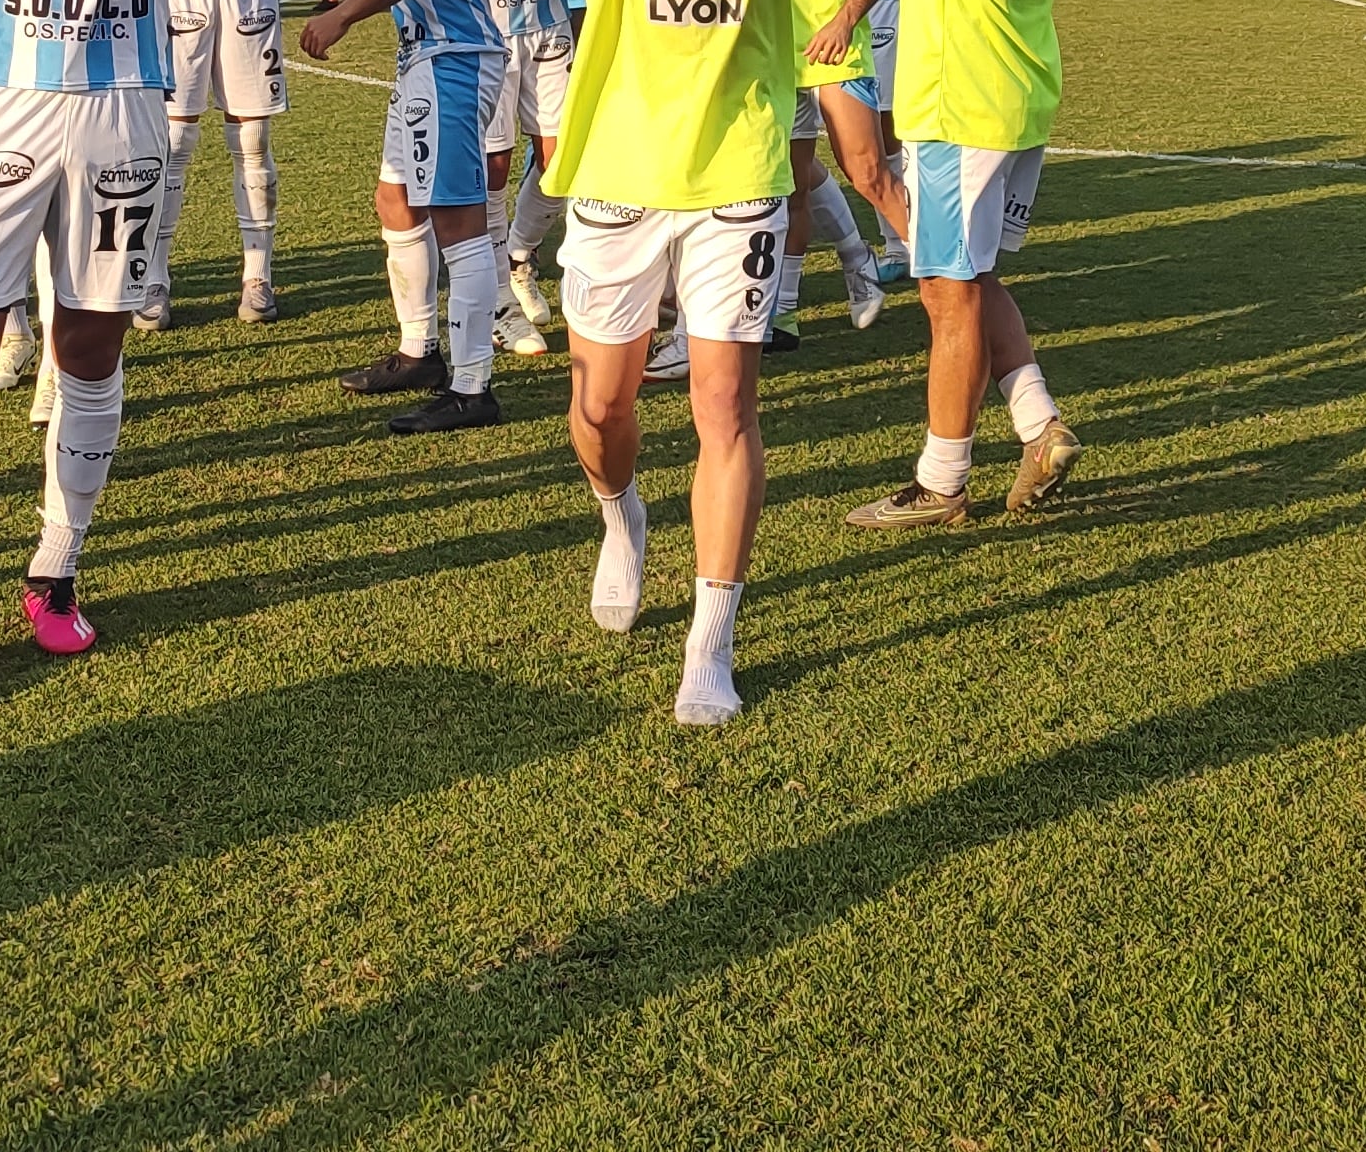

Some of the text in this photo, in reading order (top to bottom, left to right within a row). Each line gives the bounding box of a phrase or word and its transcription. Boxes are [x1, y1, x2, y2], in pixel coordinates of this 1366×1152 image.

[262, 48, 282, 77] 2
[412, 129, 430, 163] 5
[92, 202, 155, 252] 17
[742, 230, 776, 280] 8
